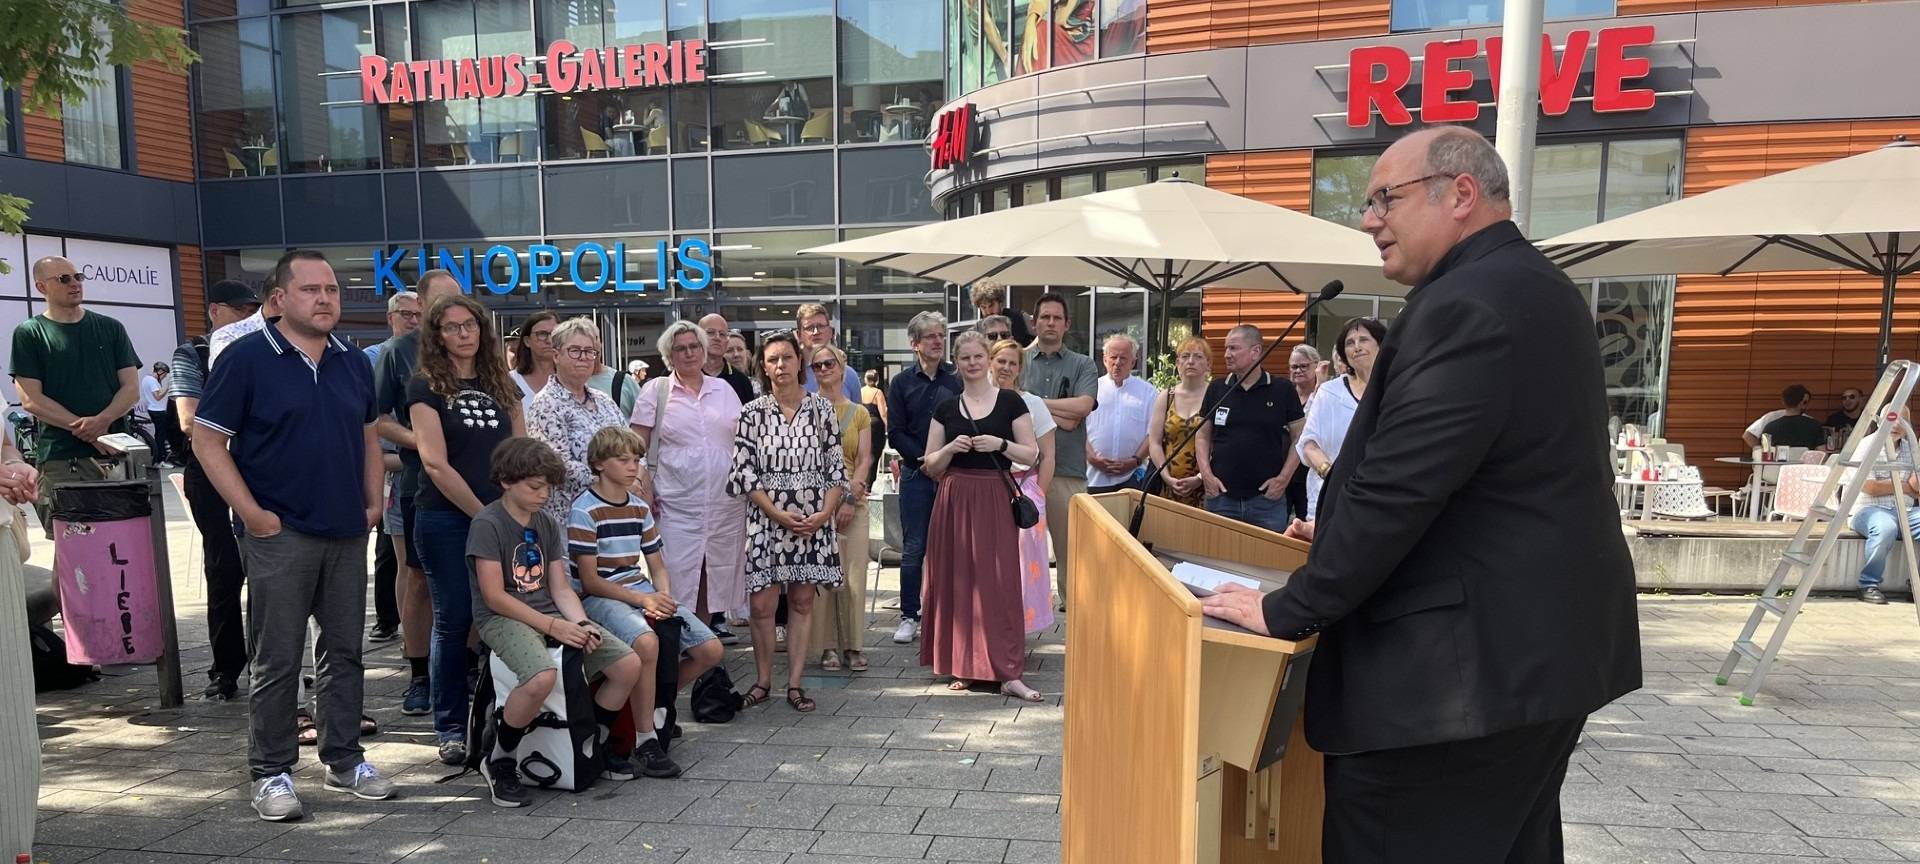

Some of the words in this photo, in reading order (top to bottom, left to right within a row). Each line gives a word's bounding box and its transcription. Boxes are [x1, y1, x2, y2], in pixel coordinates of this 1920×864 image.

[360, 40, 705, 104] RATHAUS-GALERIE
[1346, 25, 1656, 128] REWE
[931, 102, 972, 170] H&M
[372, 238, 713, 296] KINOPOLIS
